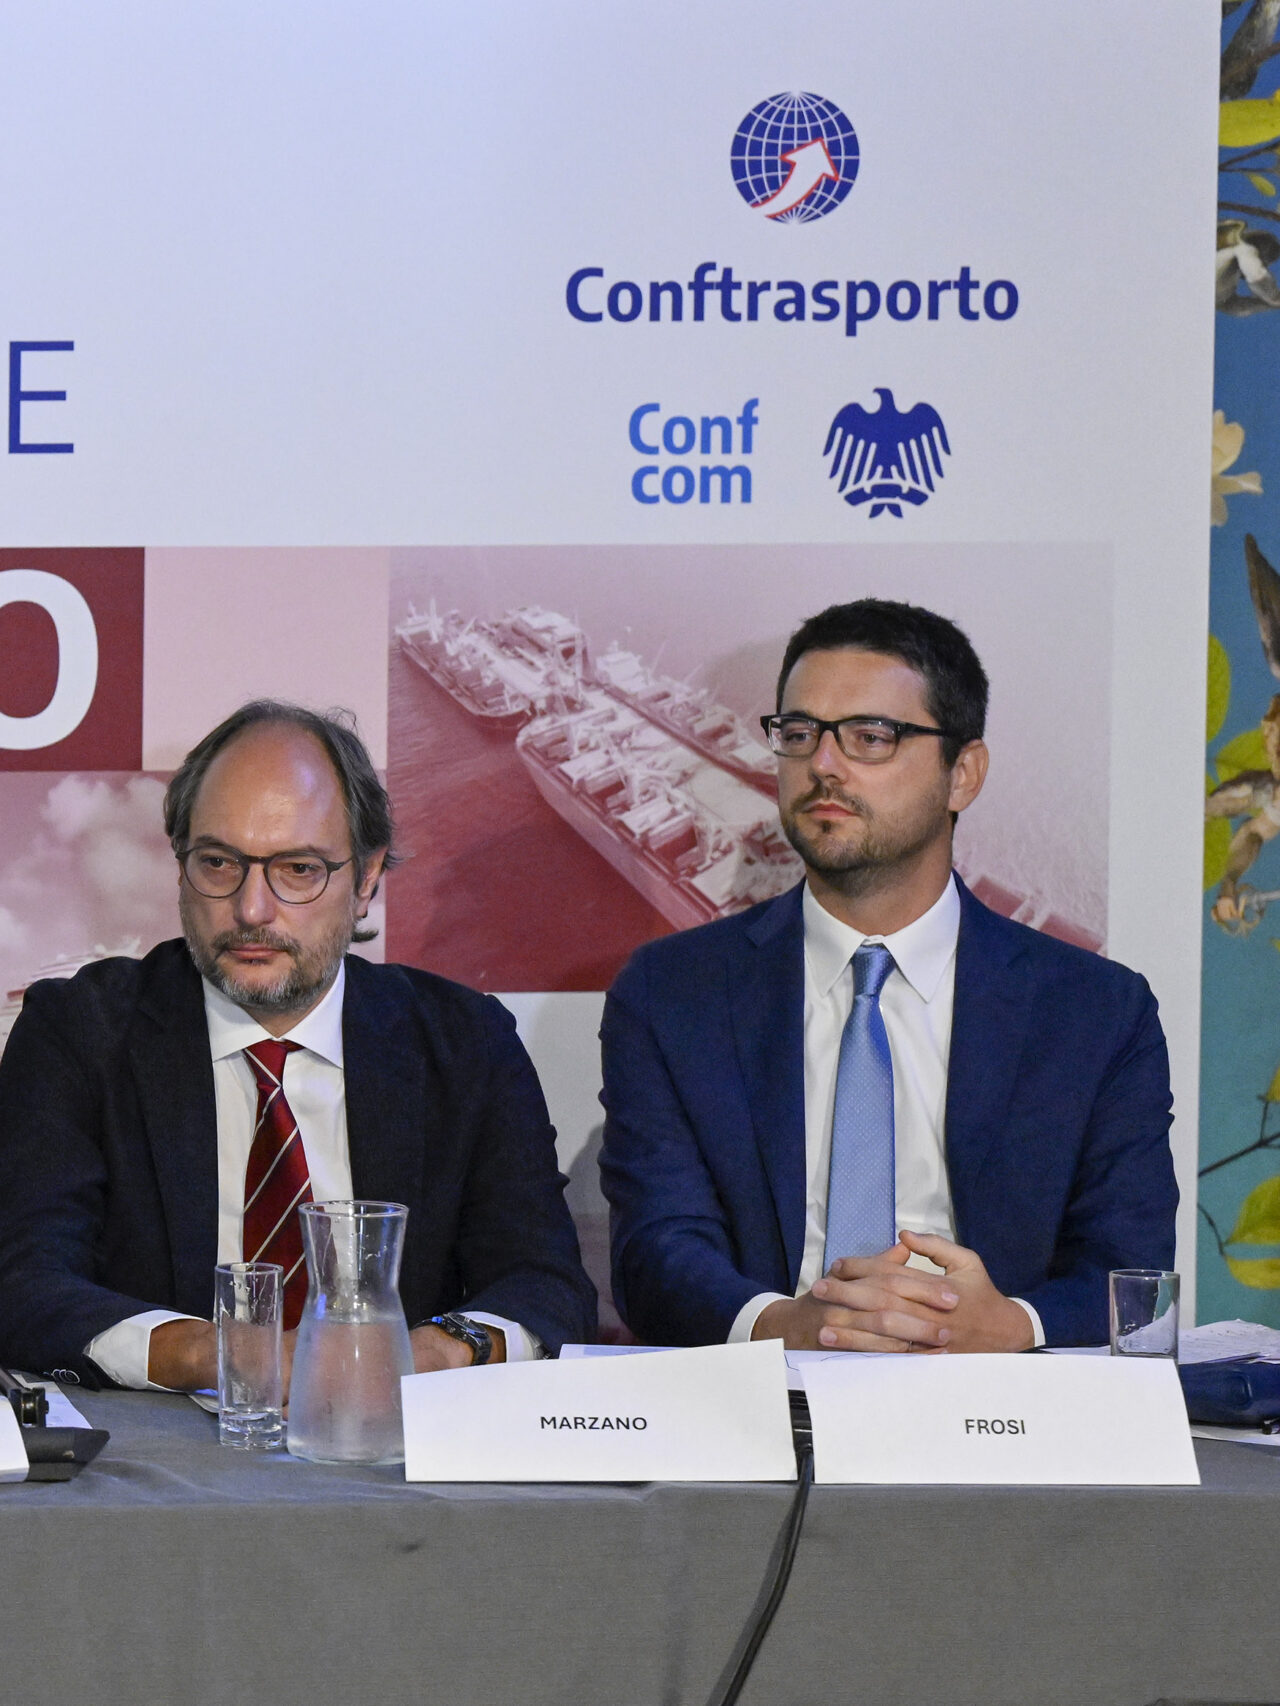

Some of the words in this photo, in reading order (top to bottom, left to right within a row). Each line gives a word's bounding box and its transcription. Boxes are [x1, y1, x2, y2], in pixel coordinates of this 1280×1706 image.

[565, 261, 1020, 338] Conftrasporto
[628, 397, 760, 456] Conf
[631, 464, 753, 505] com
[539, 1416, 649, 1431] MARZANO
[964, 1418, 1027, 1435] FROSI
